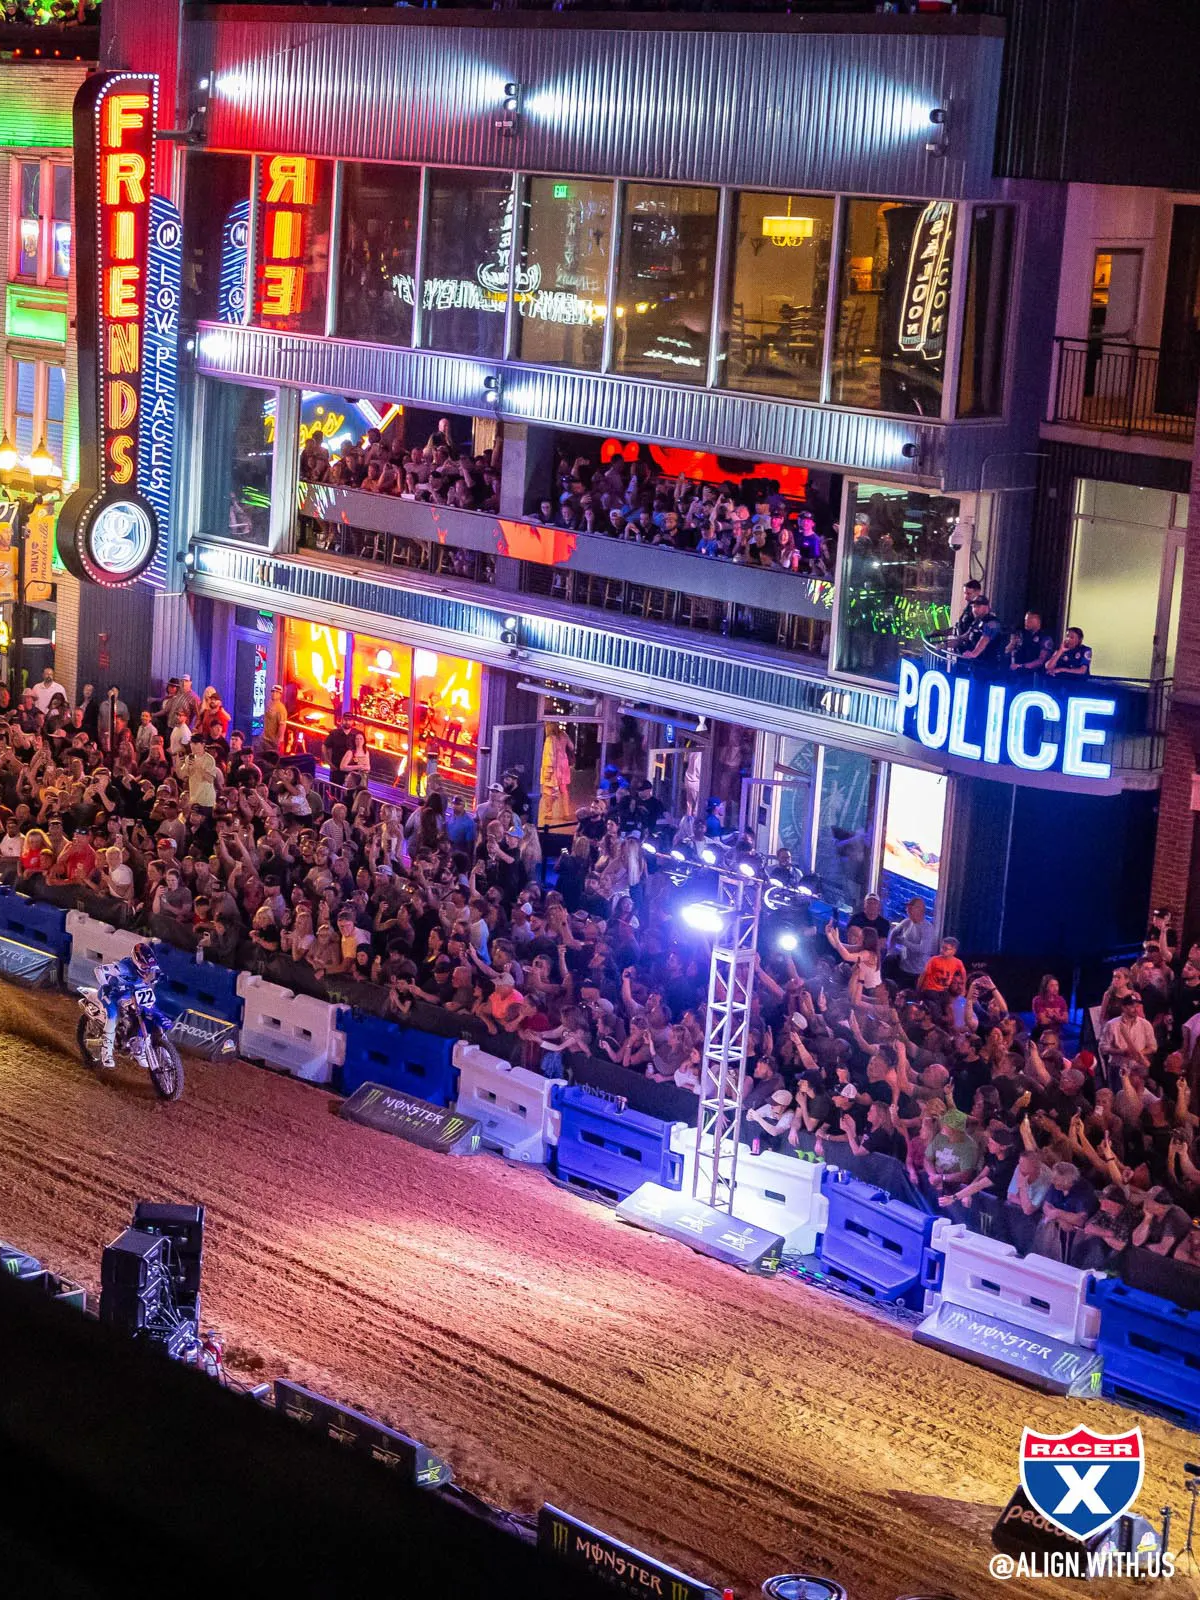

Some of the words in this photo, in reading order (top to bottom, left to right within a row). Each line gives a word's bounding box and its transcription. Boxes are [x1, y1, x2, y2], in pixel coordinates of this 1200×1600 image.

[162, 226, 176, 245] IN
[105, 95, 150, 484] FRIENDS
[150, 346, 170, 490] PLACES
[897, 657, 1116, 779] POLICE
[137, 990, 155, 1005] 22
[170, 1021, 221, 1042] peacock
[382, 1096, 445, 1125] MONSTER
[383, 1109, 426, 1128] ENERGY
[967, 1321, 1053, 1360] MONSTER
[972, 1337, 1029, 1362] ENERGY
[576, 1536, 663, 1595] MONSTER
